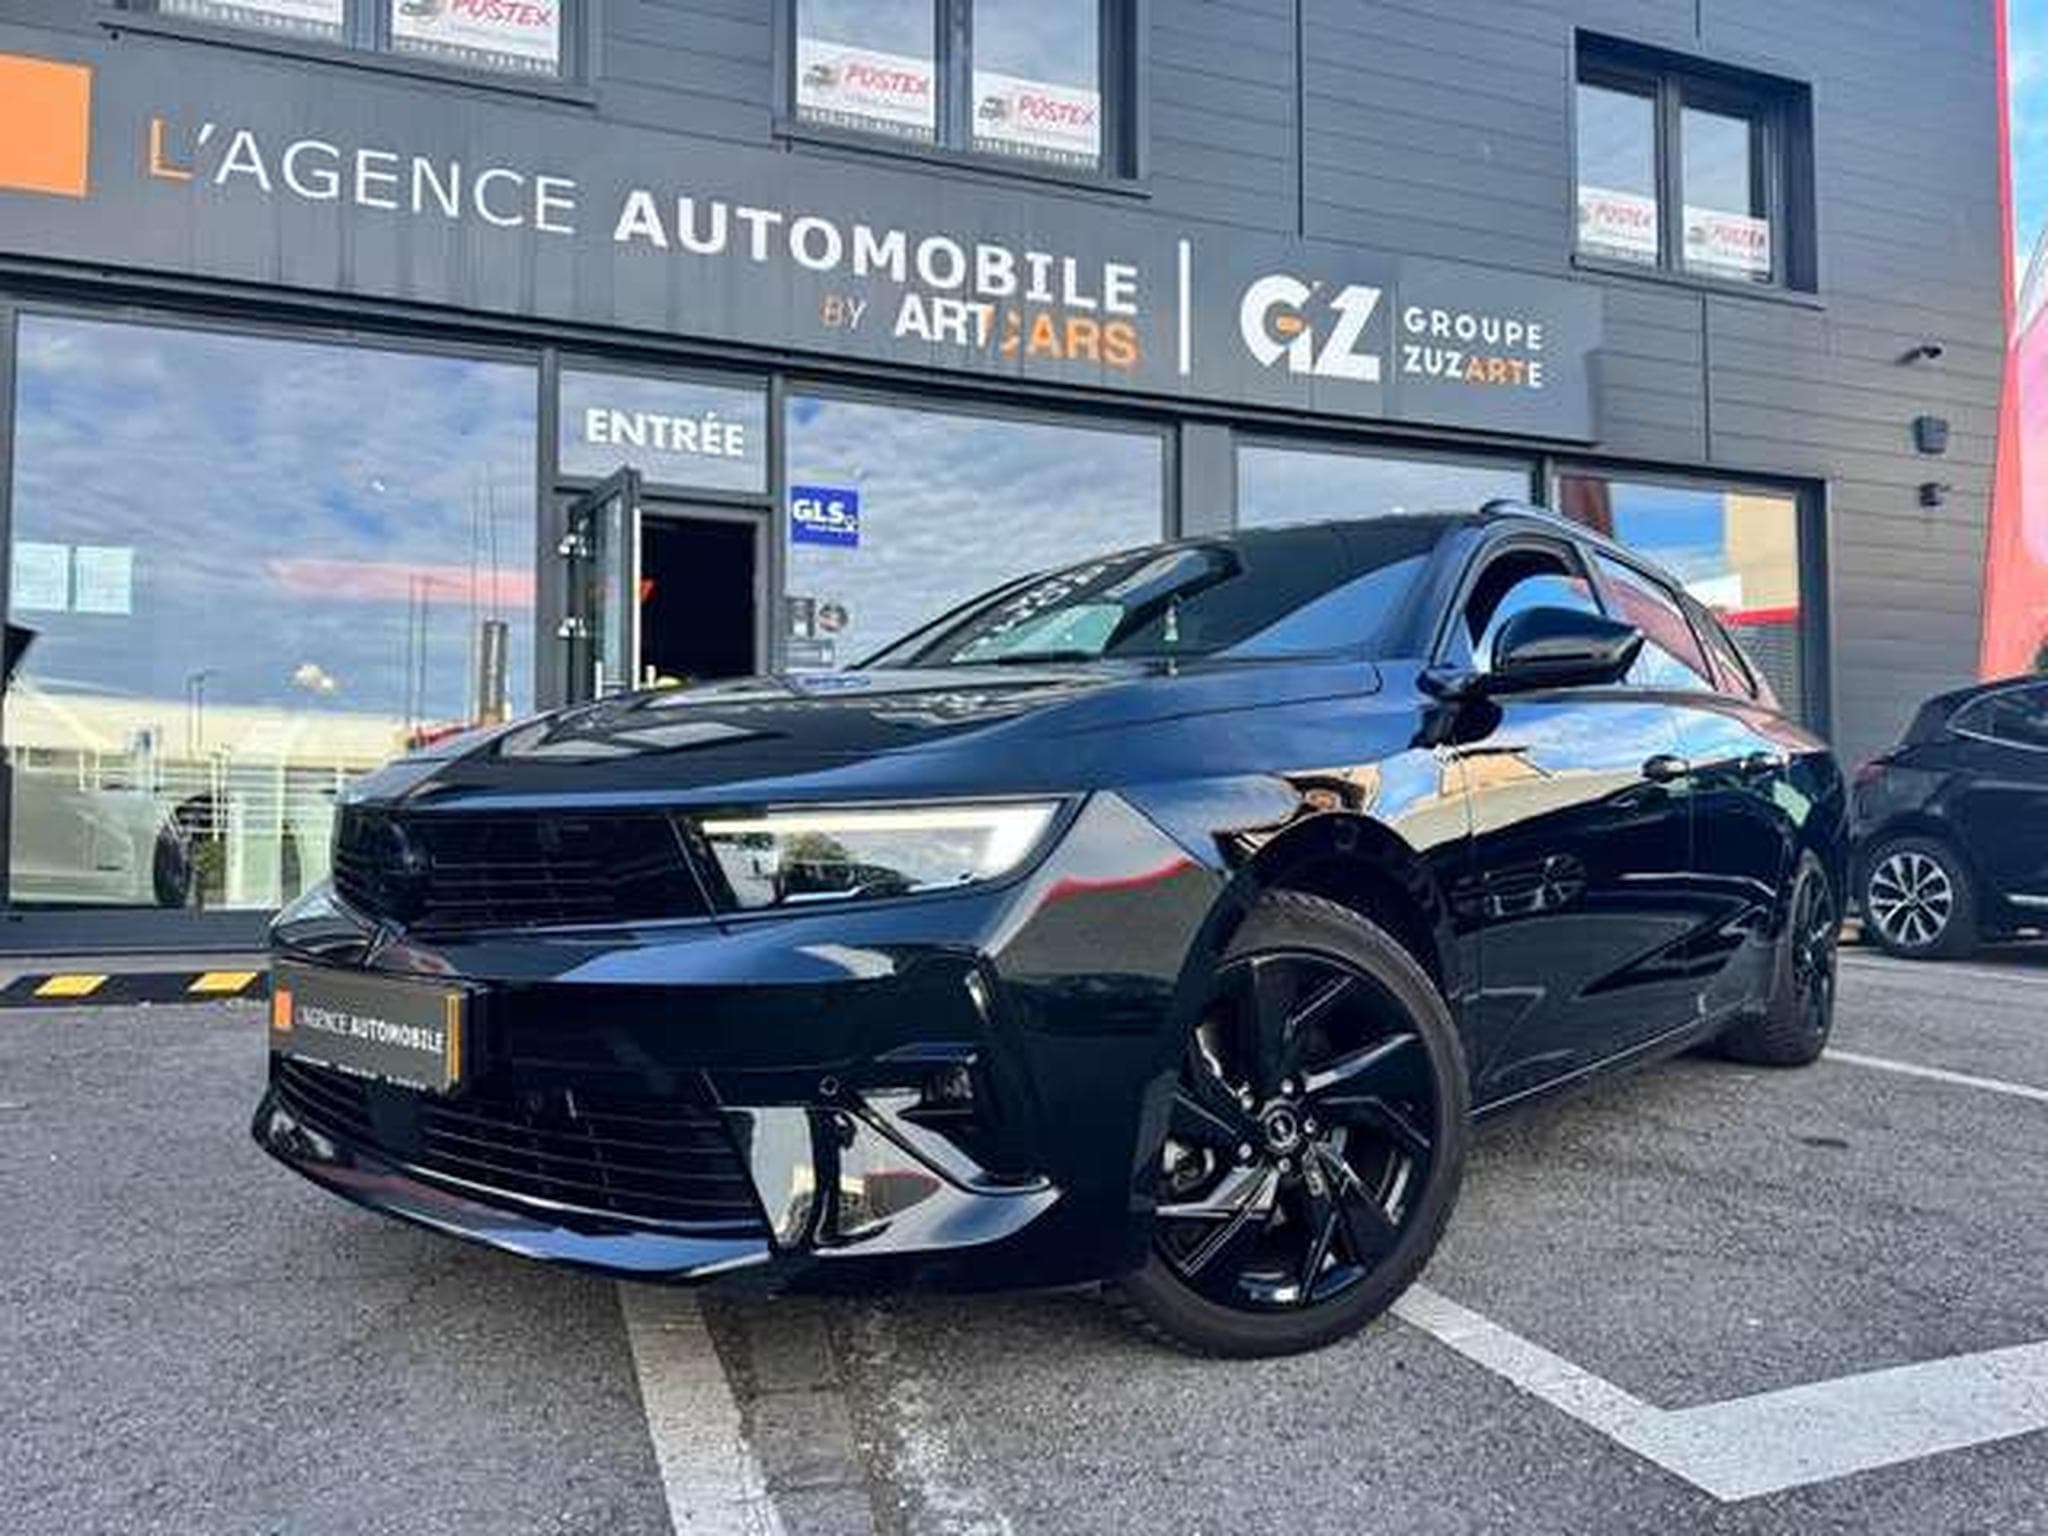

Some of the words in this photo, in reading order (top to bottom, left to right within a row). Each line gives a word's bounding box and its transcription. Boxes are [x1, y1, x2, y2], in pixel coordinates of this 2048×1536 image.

[844, 63, 929, 95] POSTEX
[1018, 94, 1096, 126] POSTEX
[148, 115, 579, 235] L'AGENCE
[613, 189, 1140, 314] AUTOMOBILE
[820, 295, 867, 330] BY
[1403, 305, 1544, 351] GROUPE
[1403, 344, 1544, 389] ZUZARTE
[586, 408, 745, 457] ENTRÉE
[351, 1015, 444, 1055] AUTOMOBILE
